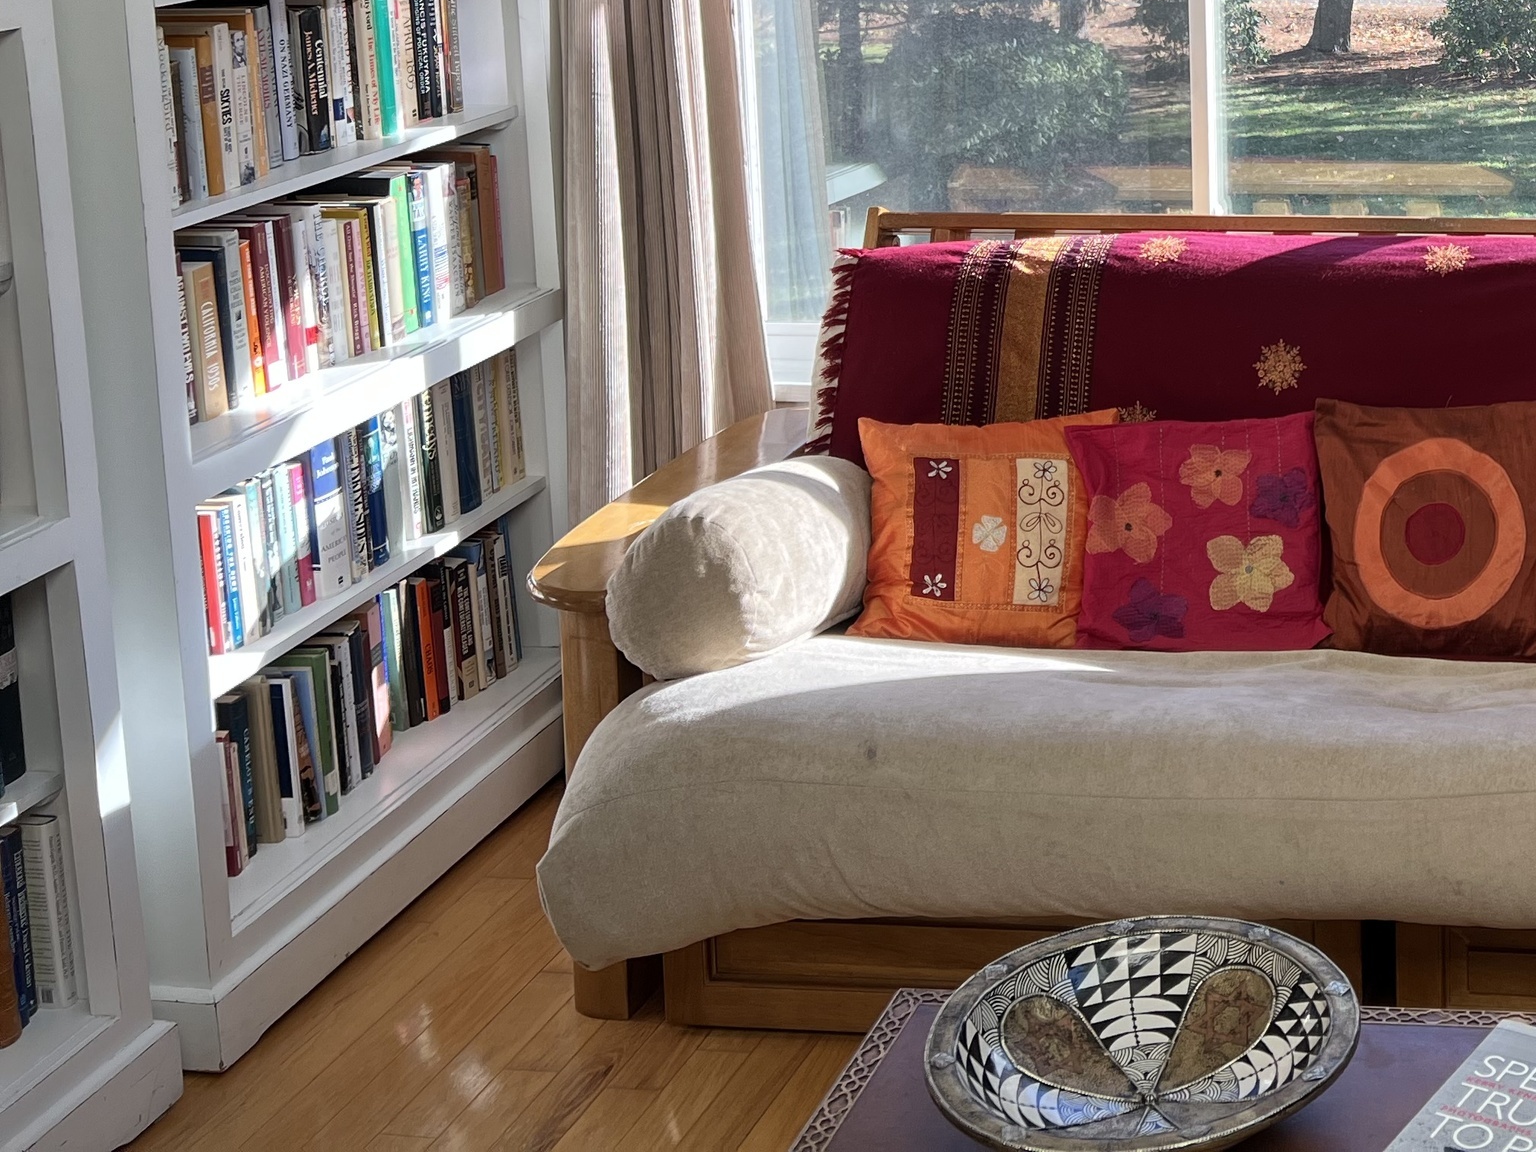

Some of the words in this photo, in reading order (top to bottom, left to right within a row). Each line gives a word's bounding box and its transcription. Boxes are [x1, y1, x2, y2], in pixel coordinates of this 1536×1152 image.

[279, 39, 285, 52] ON
[403, 16, 412, 55] APRIL
[280, 56, 288, 78] NAZI
[315, 40, 328, 98] Centennial
[406, 59, 415, 90] 1865
[158, 39, 172, 132] Mockingbird
[220, 89, 232, 125] SIXTIES
[283, 82, 293, 129] GERMANY
[417, 234, 429, 272] LARRY
[259, 266, 269, 307] AMERICAN
[421, 277, 431, 304] KING
[200, 301, 218, 358] CALIFORNIA
[261, 309, 272, 348] VIOLENCE
[206, 364, 221, 391] 1930s
[424, 643, 433, 675] CHAOS
[1466, 1075, 1505, 1090] KERRY
[1429, 1112, 1494, 1149] TO
[1441, 1104, 1533, 1137] PHOTOGRAPHS
